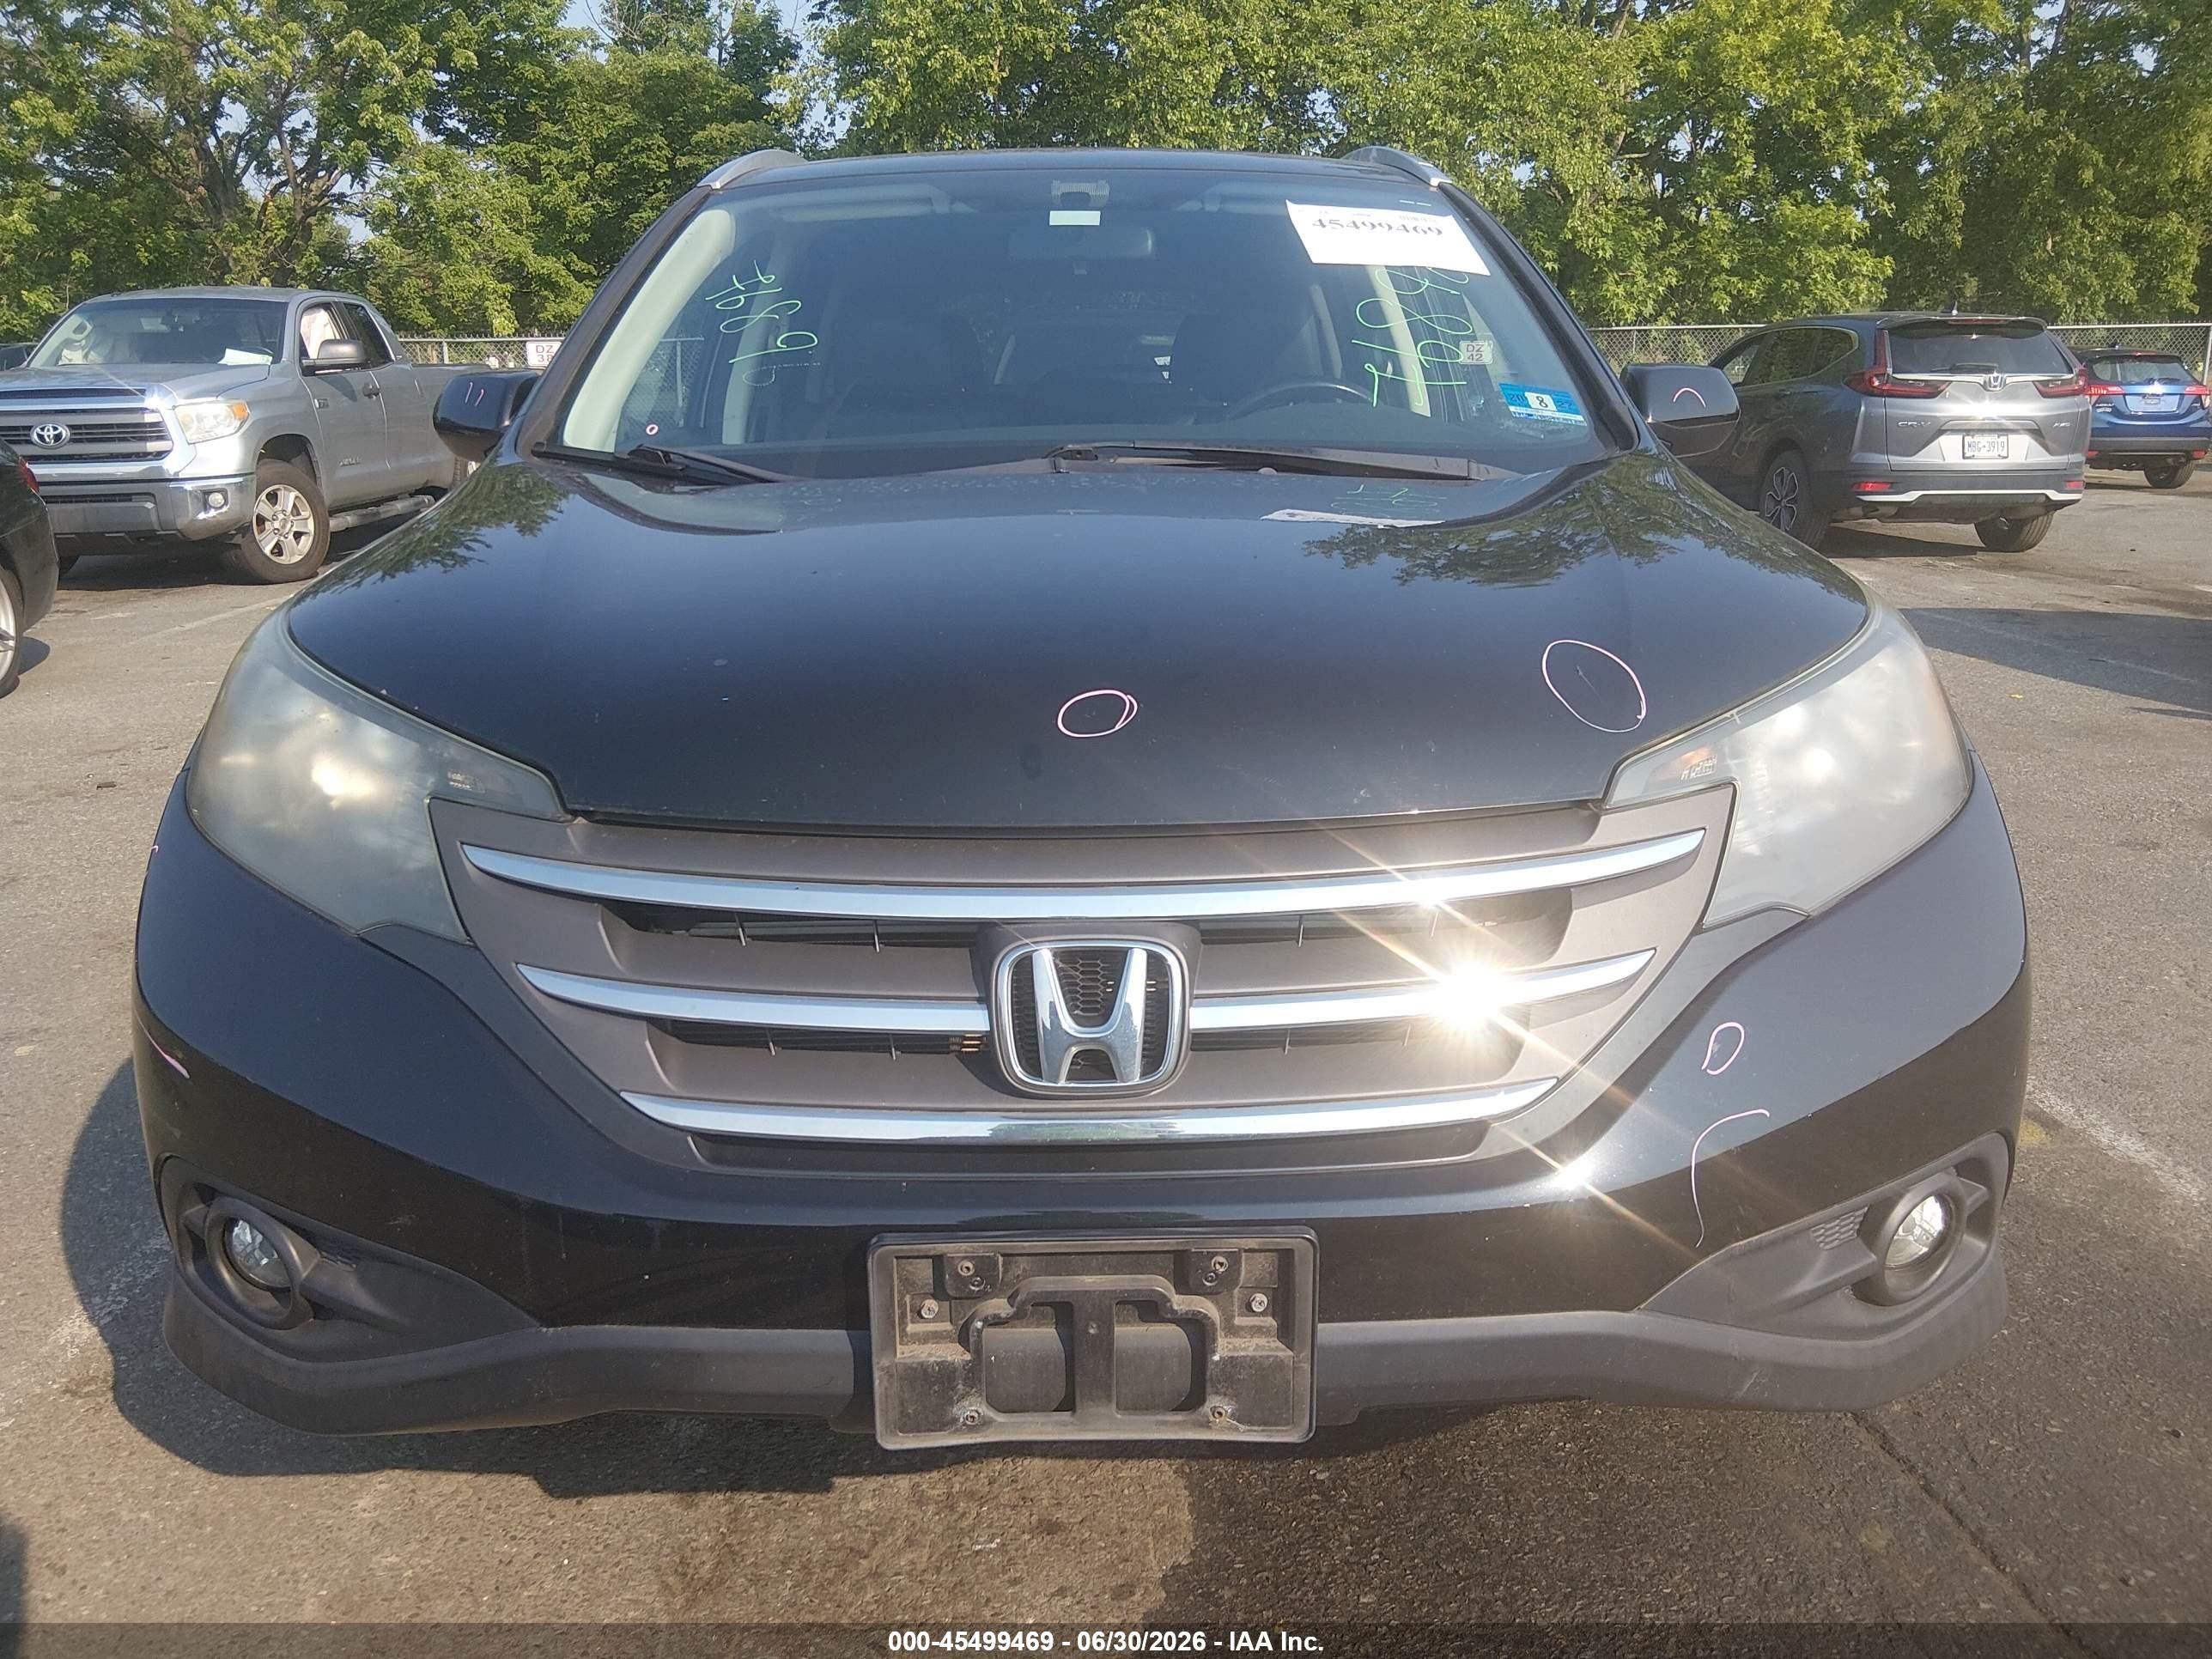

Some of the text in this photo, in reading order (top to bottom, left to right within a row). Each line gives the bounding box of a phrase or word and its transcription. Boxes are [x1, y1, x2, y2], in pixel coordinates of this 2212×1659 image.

[536, 344, 555, 354] DZ
[1466, 343, 1485, 353] DZ
[1467, 353, 1484, 362] 42
[1535, 395, 1549, 409] 8
